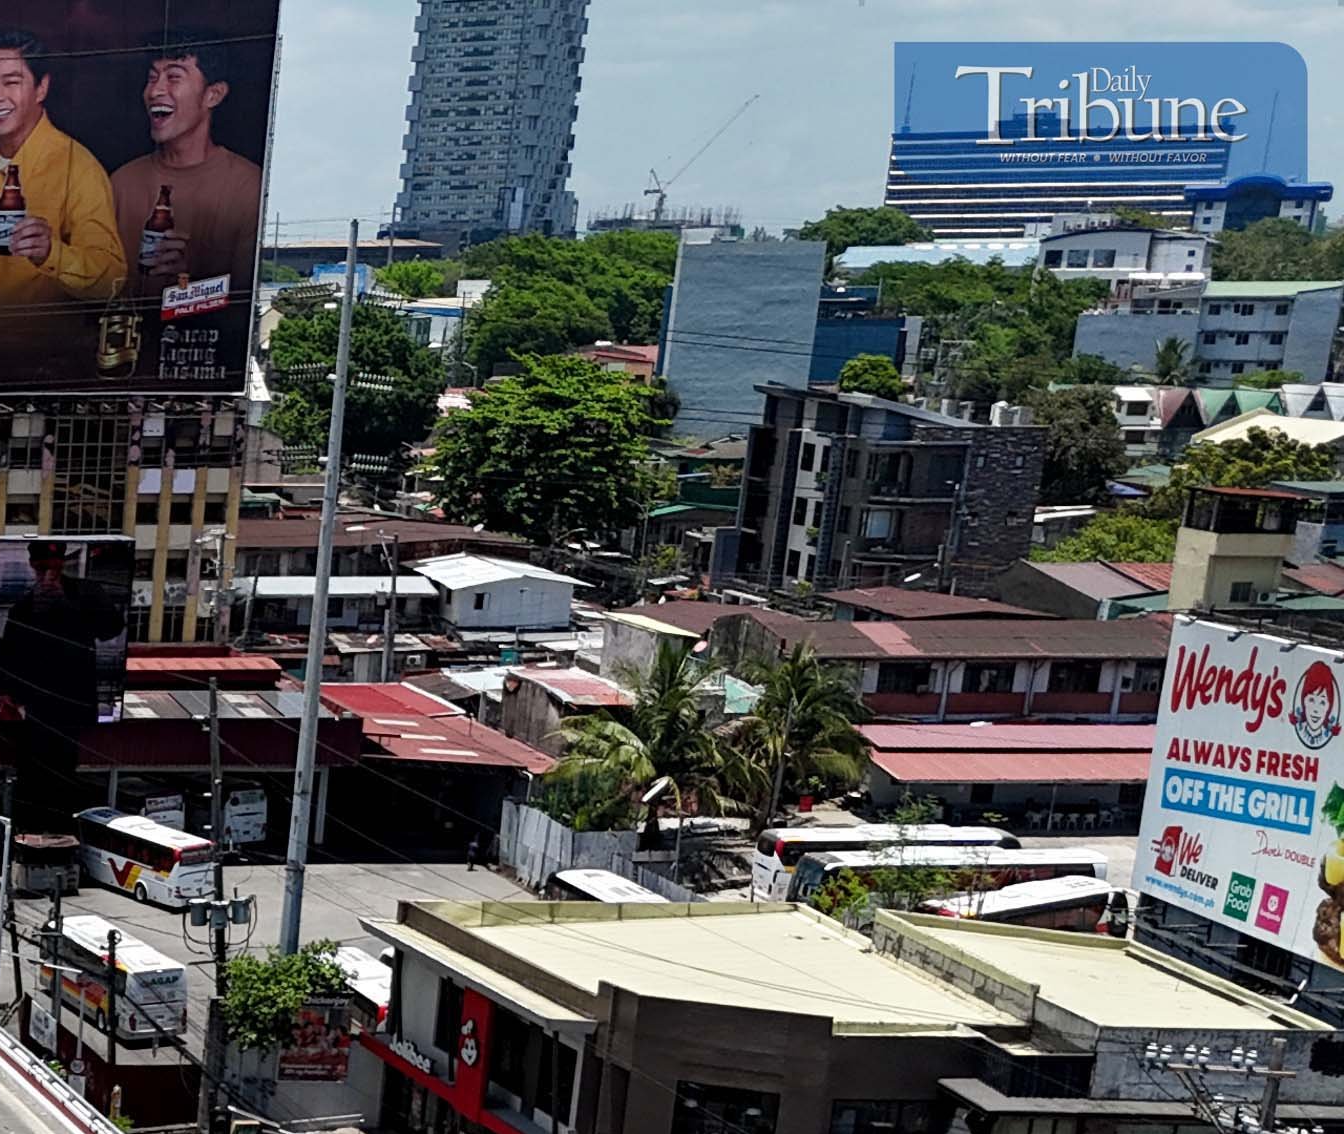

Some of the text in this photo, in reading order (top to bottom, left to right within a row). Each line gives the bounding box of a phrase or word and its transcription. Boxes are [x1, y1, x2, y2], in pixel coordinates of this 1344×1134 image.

[1170, 643, 1287, 733] Wendy's
[1166, 737, 1320, 783] ALWAYS FRESH
[1165, 775, 1312, 827] OFF THE GRILL
[1178, 832, 1204, 867] We
[1283, 851, 1317, 869] DOUBLE
[1179, 865, 1219, 891] DELIVER
[1230, 880, 1253, 899] Grab
[1225, 894, 1250, 913] Food
